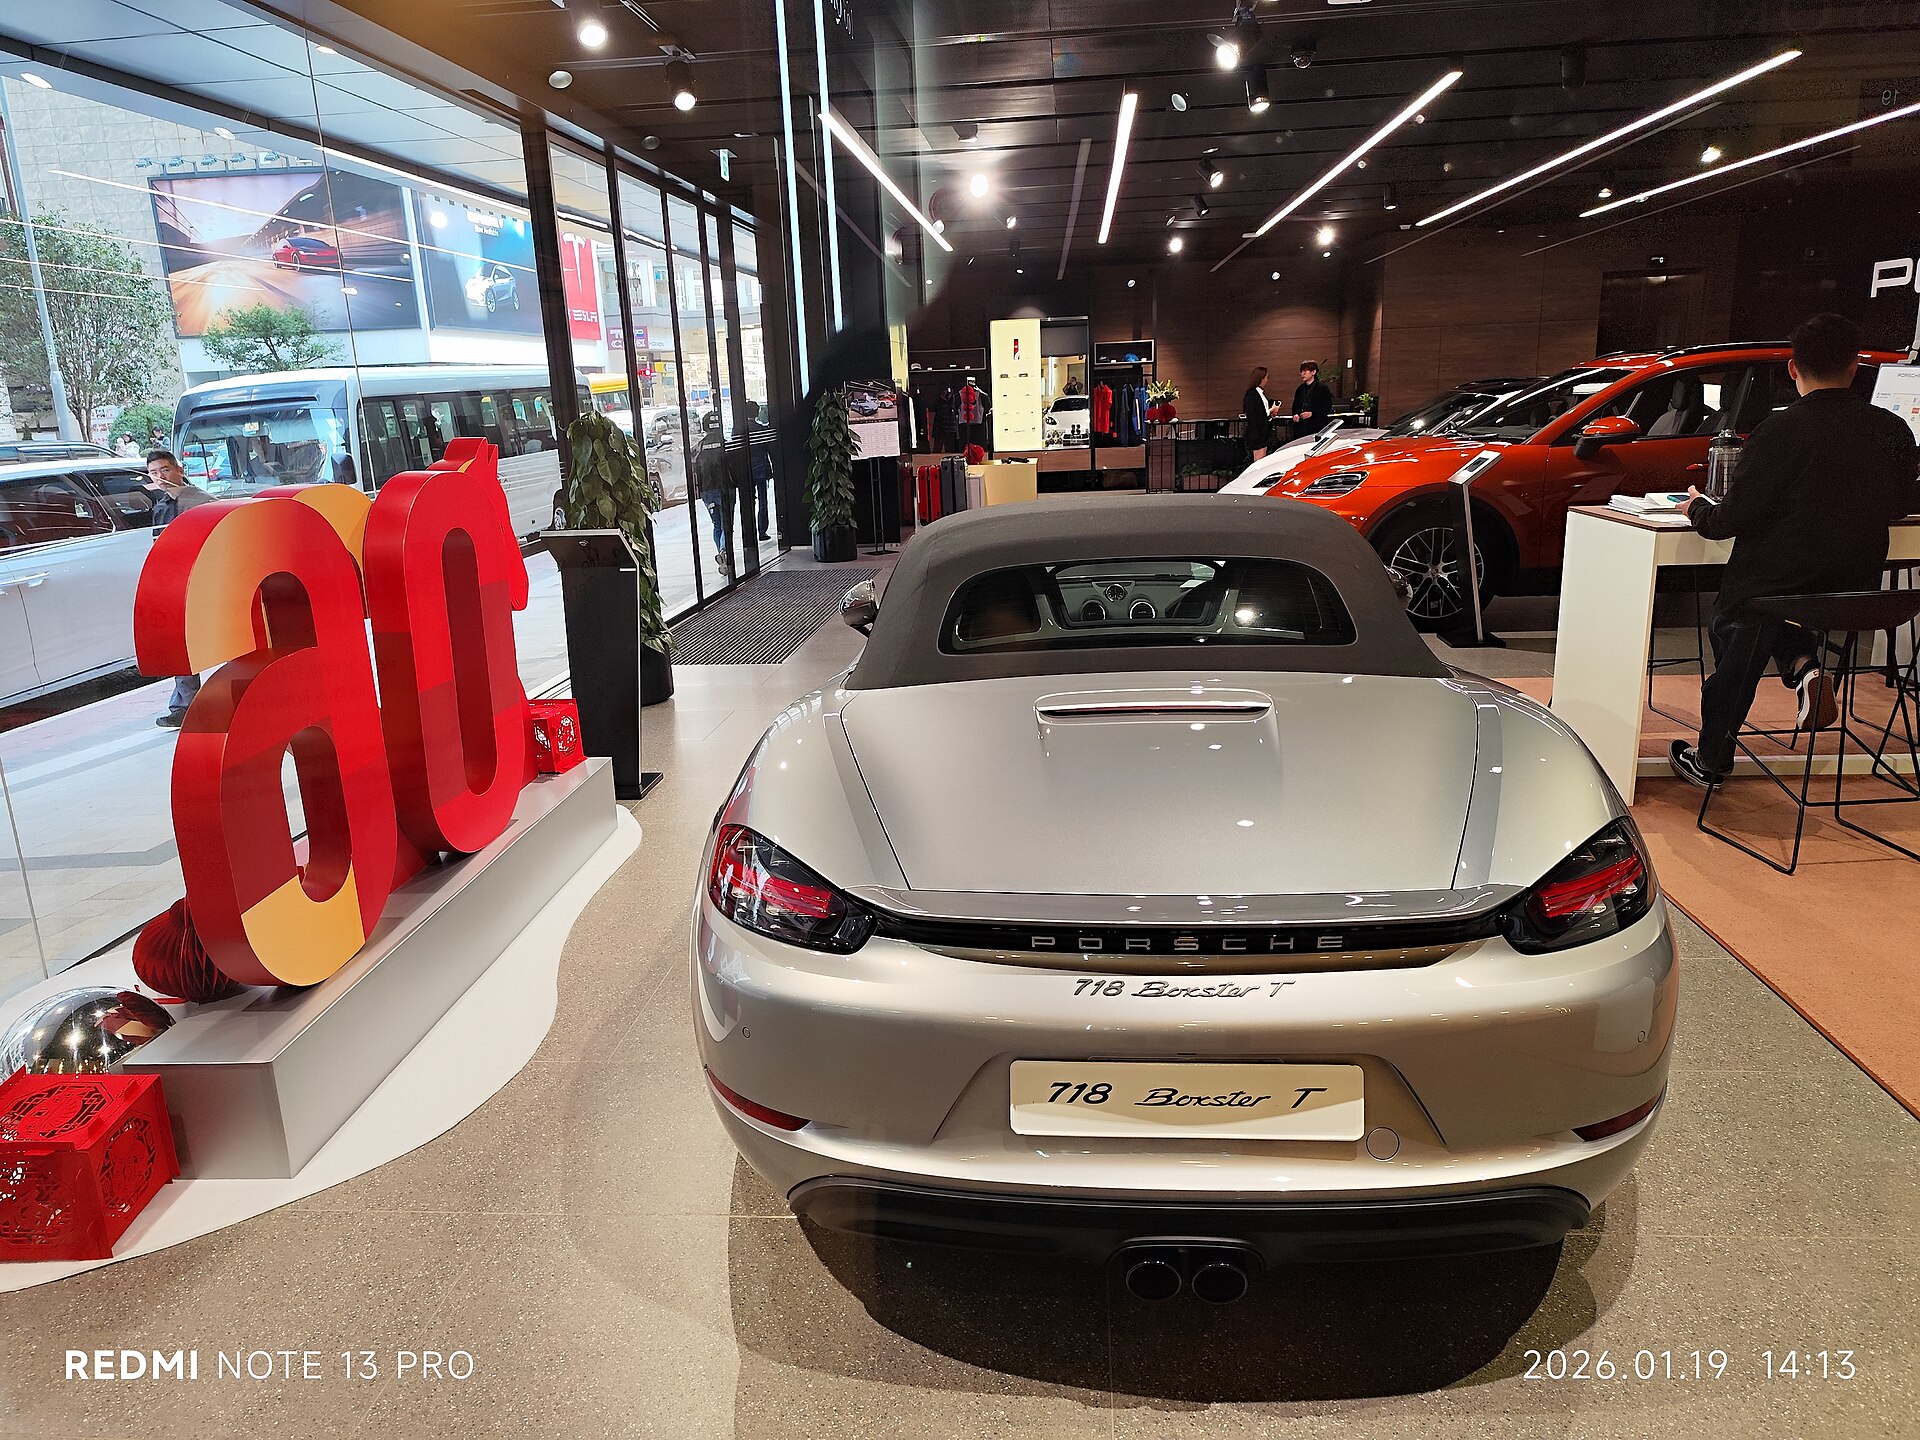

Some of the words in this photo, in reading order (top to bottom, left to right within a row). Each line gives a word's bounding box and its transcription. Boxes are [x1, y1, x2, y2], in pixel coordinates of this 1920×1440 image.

[1870, 256, 1920, 299] P
[568, 308, 598, 323] ESLA
[1031, 935, 1344, 951] PORSCHE
[1074, 978, 1126, 997] 718
[1131, 980, 1261, 998] Boxster
[1269, 980, 1297, 998] T
[1047, 1081, 1114, 1105] 718
[1134, 1087, 1272, 1108] Boxster
[1290, 1087, 1328, 1109] T
